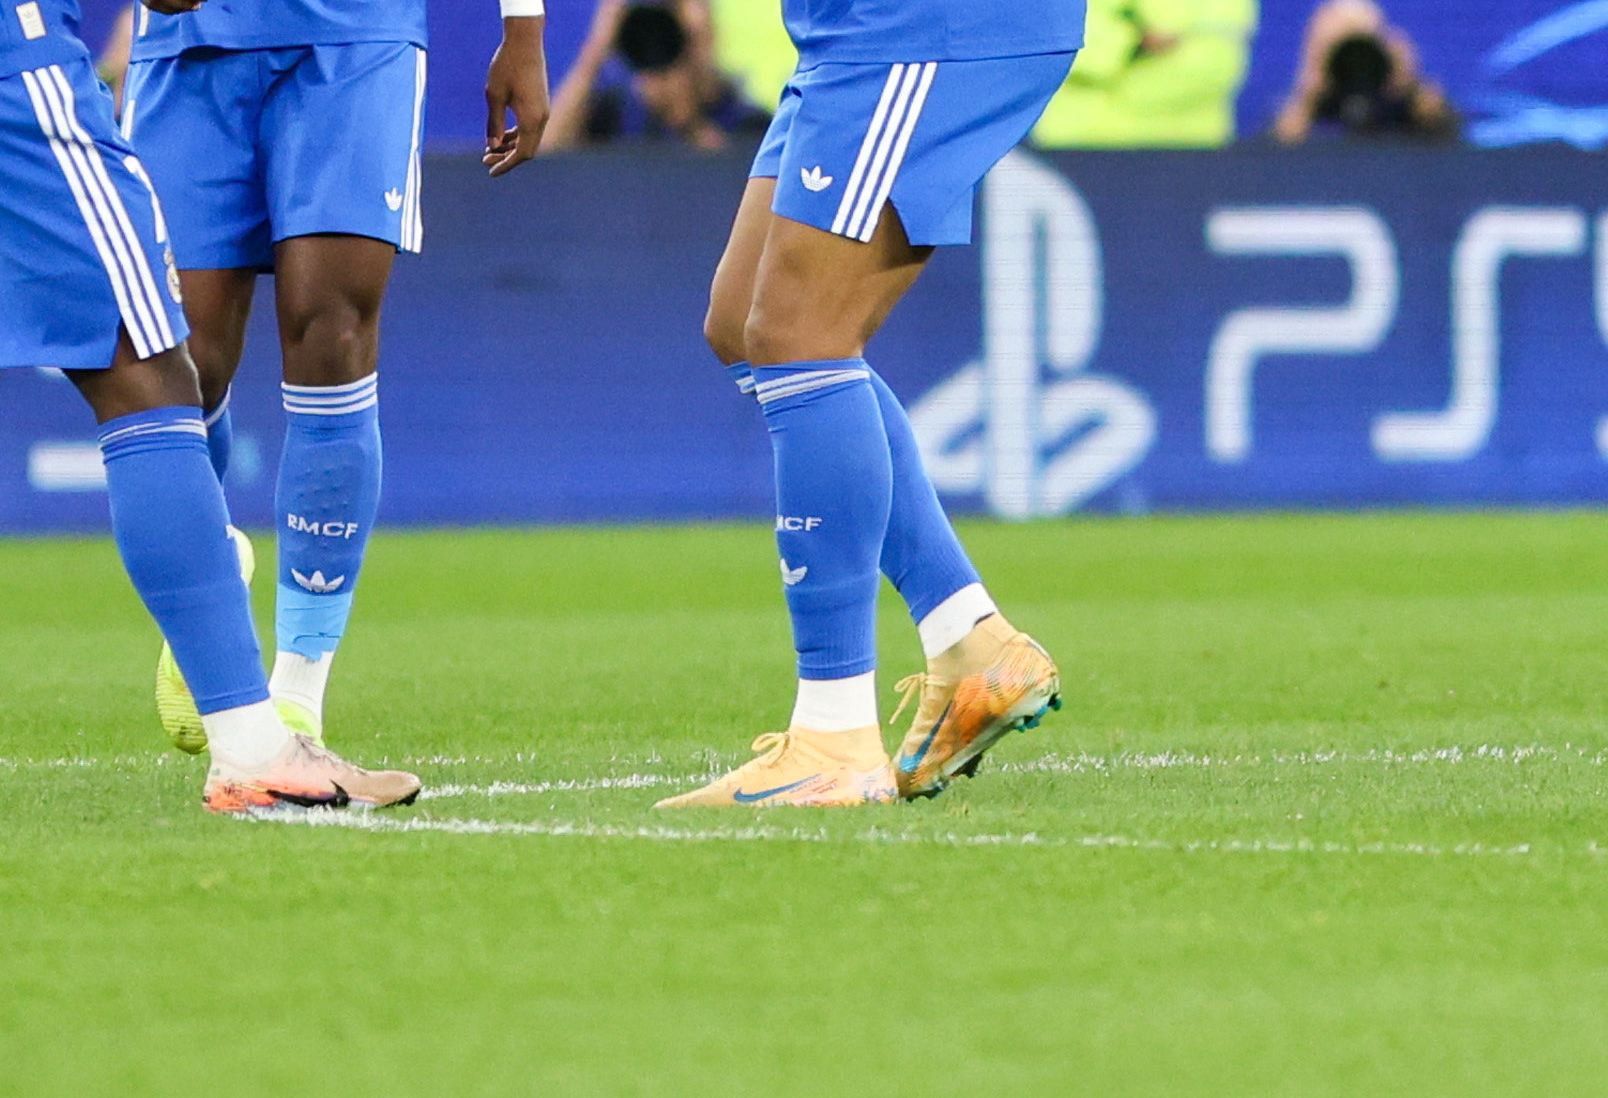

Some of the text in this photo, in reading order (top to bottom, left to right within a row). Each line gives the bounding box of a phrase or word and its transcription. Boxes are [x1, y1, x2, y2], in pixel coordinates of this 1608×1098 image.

[1204, 206, 1608, 465] PS
[287, 512, 359, 540] RMCF
[775, 514, 823, 532] CF
